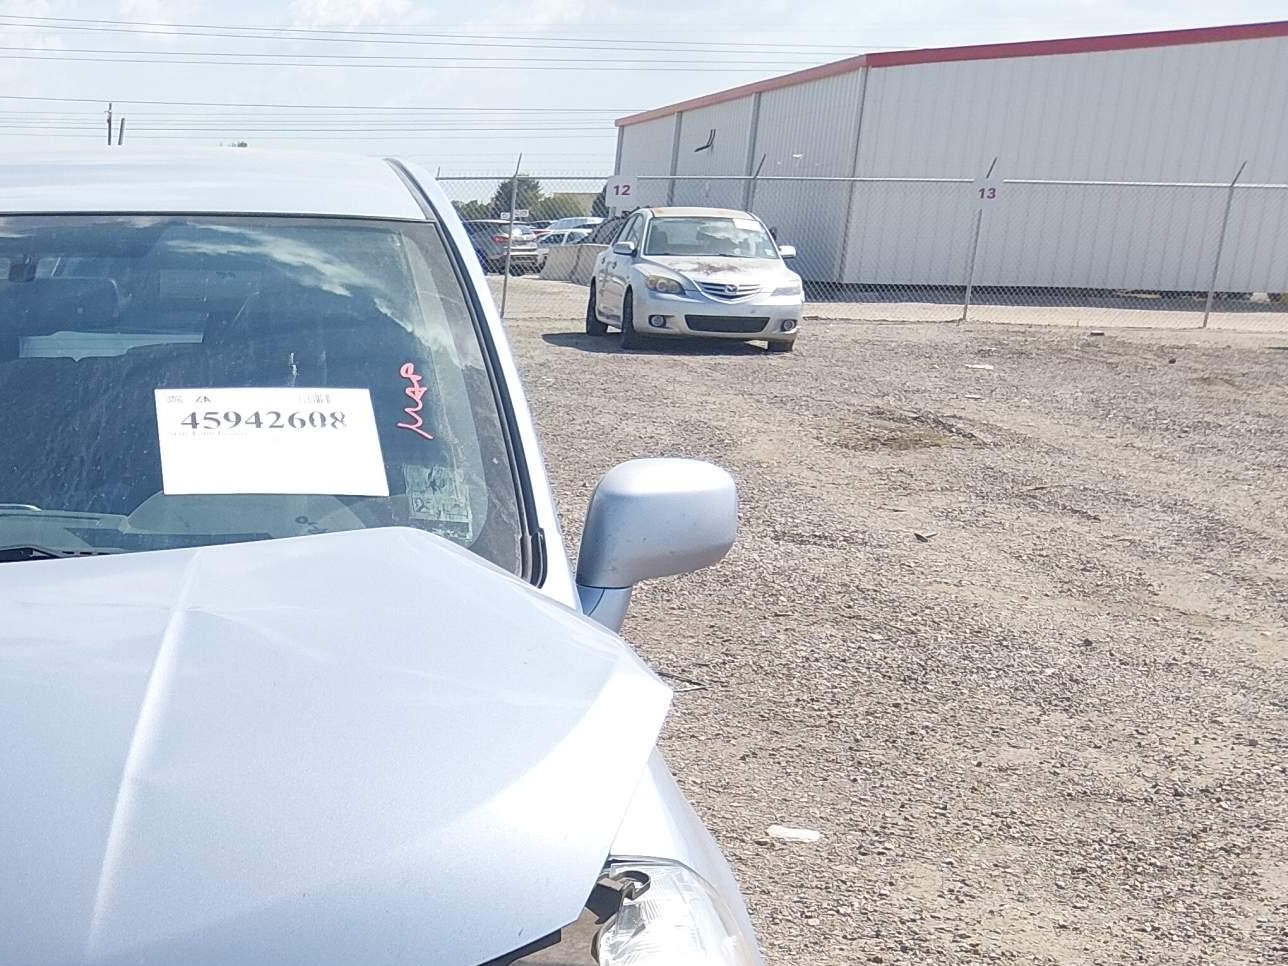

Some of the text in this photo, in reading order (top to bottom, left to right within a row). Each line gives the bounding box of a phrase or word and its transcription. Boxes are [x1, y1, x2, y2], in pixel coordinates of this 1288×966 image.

[613, 184, 631, 196] 12
[978, 187, 997, 200] 13
[180, 410, 348, 430] 45942608
